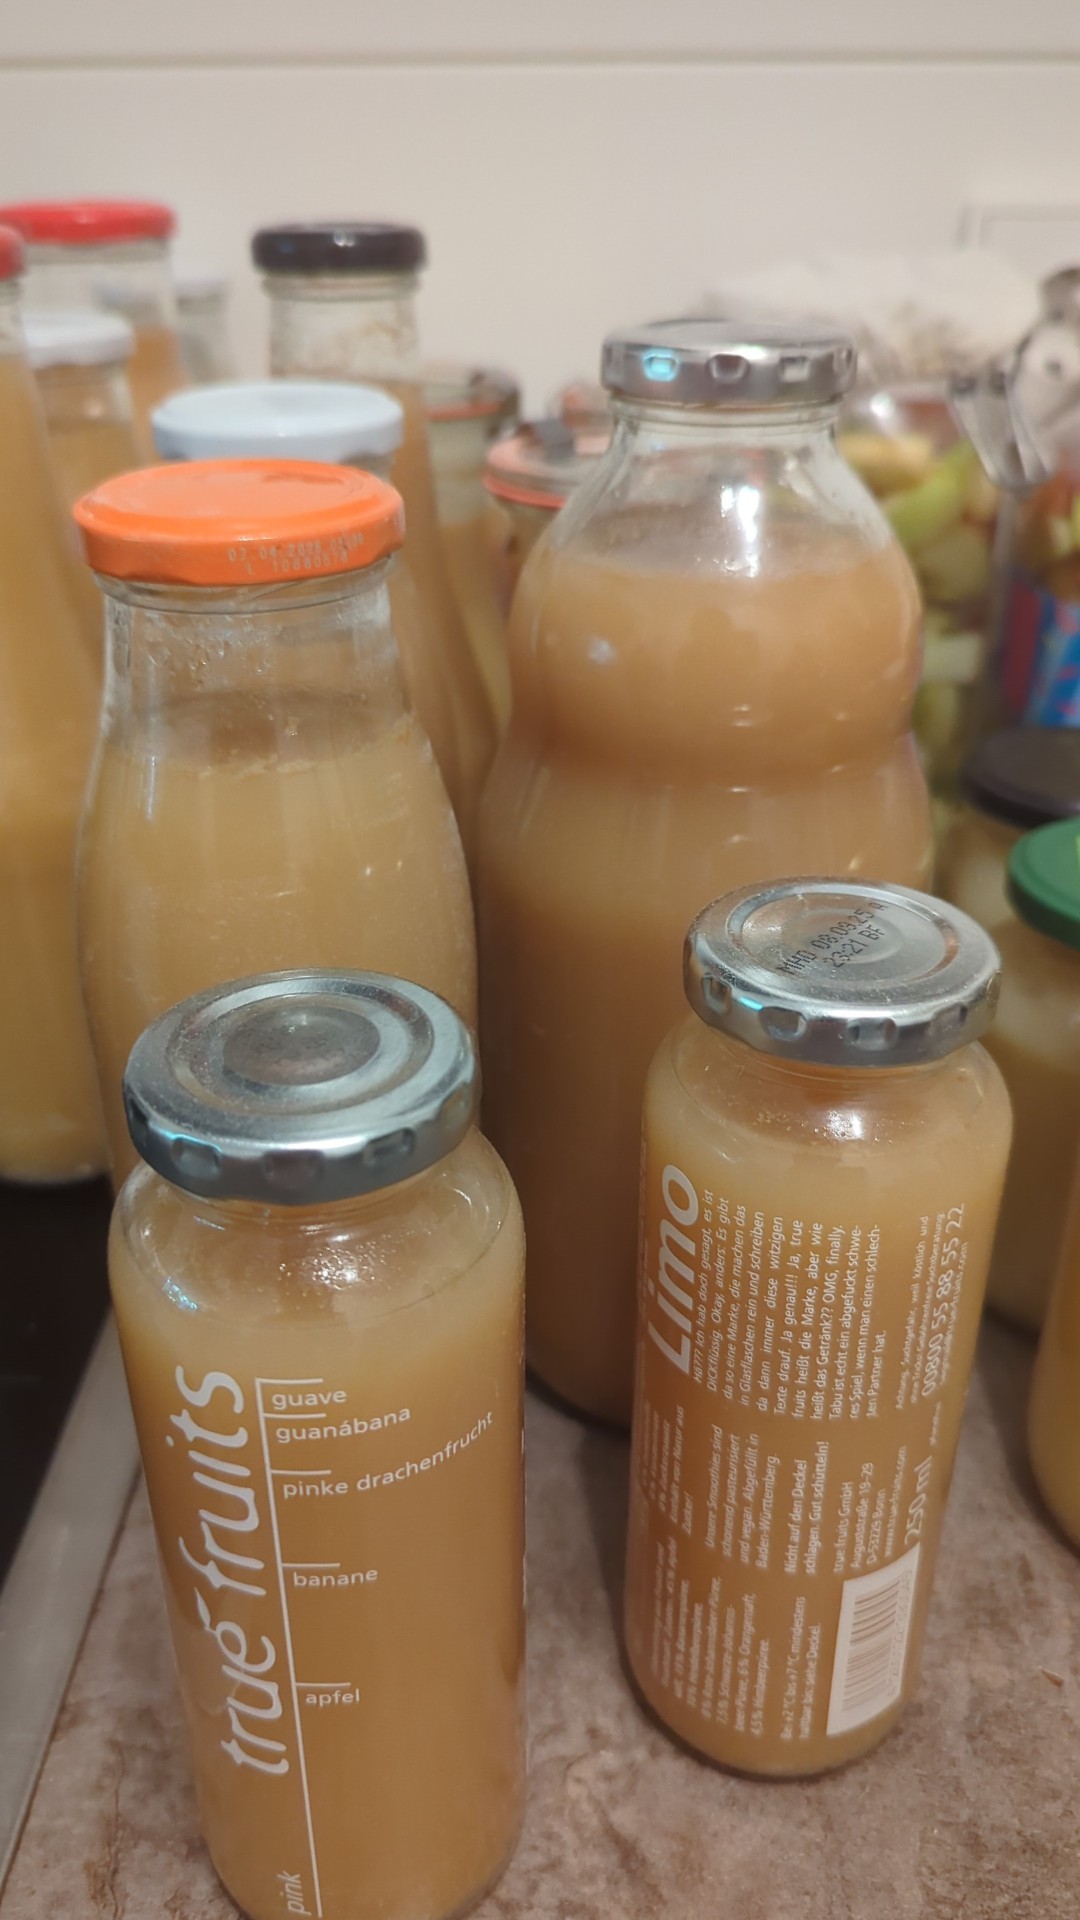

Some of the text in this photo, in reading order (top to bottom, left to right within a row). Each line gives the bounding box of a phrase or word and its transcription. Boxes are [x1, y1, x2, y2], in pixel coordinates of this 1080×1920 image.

[776, 950, 817, 976] MHD
[811, 908, 874, 951] 08.09.25
[858, 924, 885, 940] BF
[703, 1189, 713, 1204] ist
[703, 1209, 712, 1221] es
[718, 1198, 730, 1223] gibt
[716, 1229, 727, 1240] Es
[945, 1202, 964, 1233] 22
[700, 1228, 712, 1269] gesagt,
[713, 1247, 726, 1287] anders:
[941, 1238, 960, 1265] 55
[648, 1165, 699, 1374] Limo
[698, 1273, 708, 1301] doch
[823, 1269, 839, 1303] OMG,
[936, 1270, 954, 1298] 88
[696, 1305, 707, 1327] hab
[712, 1294, 725, 1323] Okay,
[723, 1205, 746, 1399] da so eine Marke, die machen das
[740, 1212, 764, 1405] in Glasflaschen rein und schreiben
[756, 1217, 785, 1411] da dann immer diese witzigen
[774, 1220, 803, 1414] Texte drauf. Ja genau!!! Ja, true
[792, 1223, 823, 1418] fruits heißt die Marke, aber wie
[932, 1303, 948, 1329] 55
[695, 1330, 705, 1346] Ich
[816, 1308, 834, 1364] Getränk??
[829, 1225, 861, 1419] Tabu ist echt ein abgefuckt schwe-
[848, 1224, 880, 1419] res Spiel, wenn man einen schlech-
[814, 1369, 827, 1387] das
[866, 1330, 886, 1416] ten Partner hat.
[921, 1333, 943, 1396] 00800
[271, 1390, 347, 1410] guave
[811, 1391, 824, 1419] heißt
[276, 1407, 411, 1444] guanábana
[748, 1433, 759, 1445] in
[283, 1411, 493, 1499] pinke drachenfrucht
[705, 1424, 723, 1548] Unsere Smoothies sind
[742, 1448, 759, 1501] Abgefüllt
[721, 1434, 740, 1557] schonend pasteurisiert
[904, 1455, 932, 1545] 250 ml
[784, 1459, 807, 1573] Nicht auf den Deckel
[166, 1365, 289, 1775] true fruits
[738, 1540, 750, 1563] und
[293, 1569, 378, 1587] banane
[305, 1688, 360, 1708] apfel
[276, 1870, 312, 1917] pink
